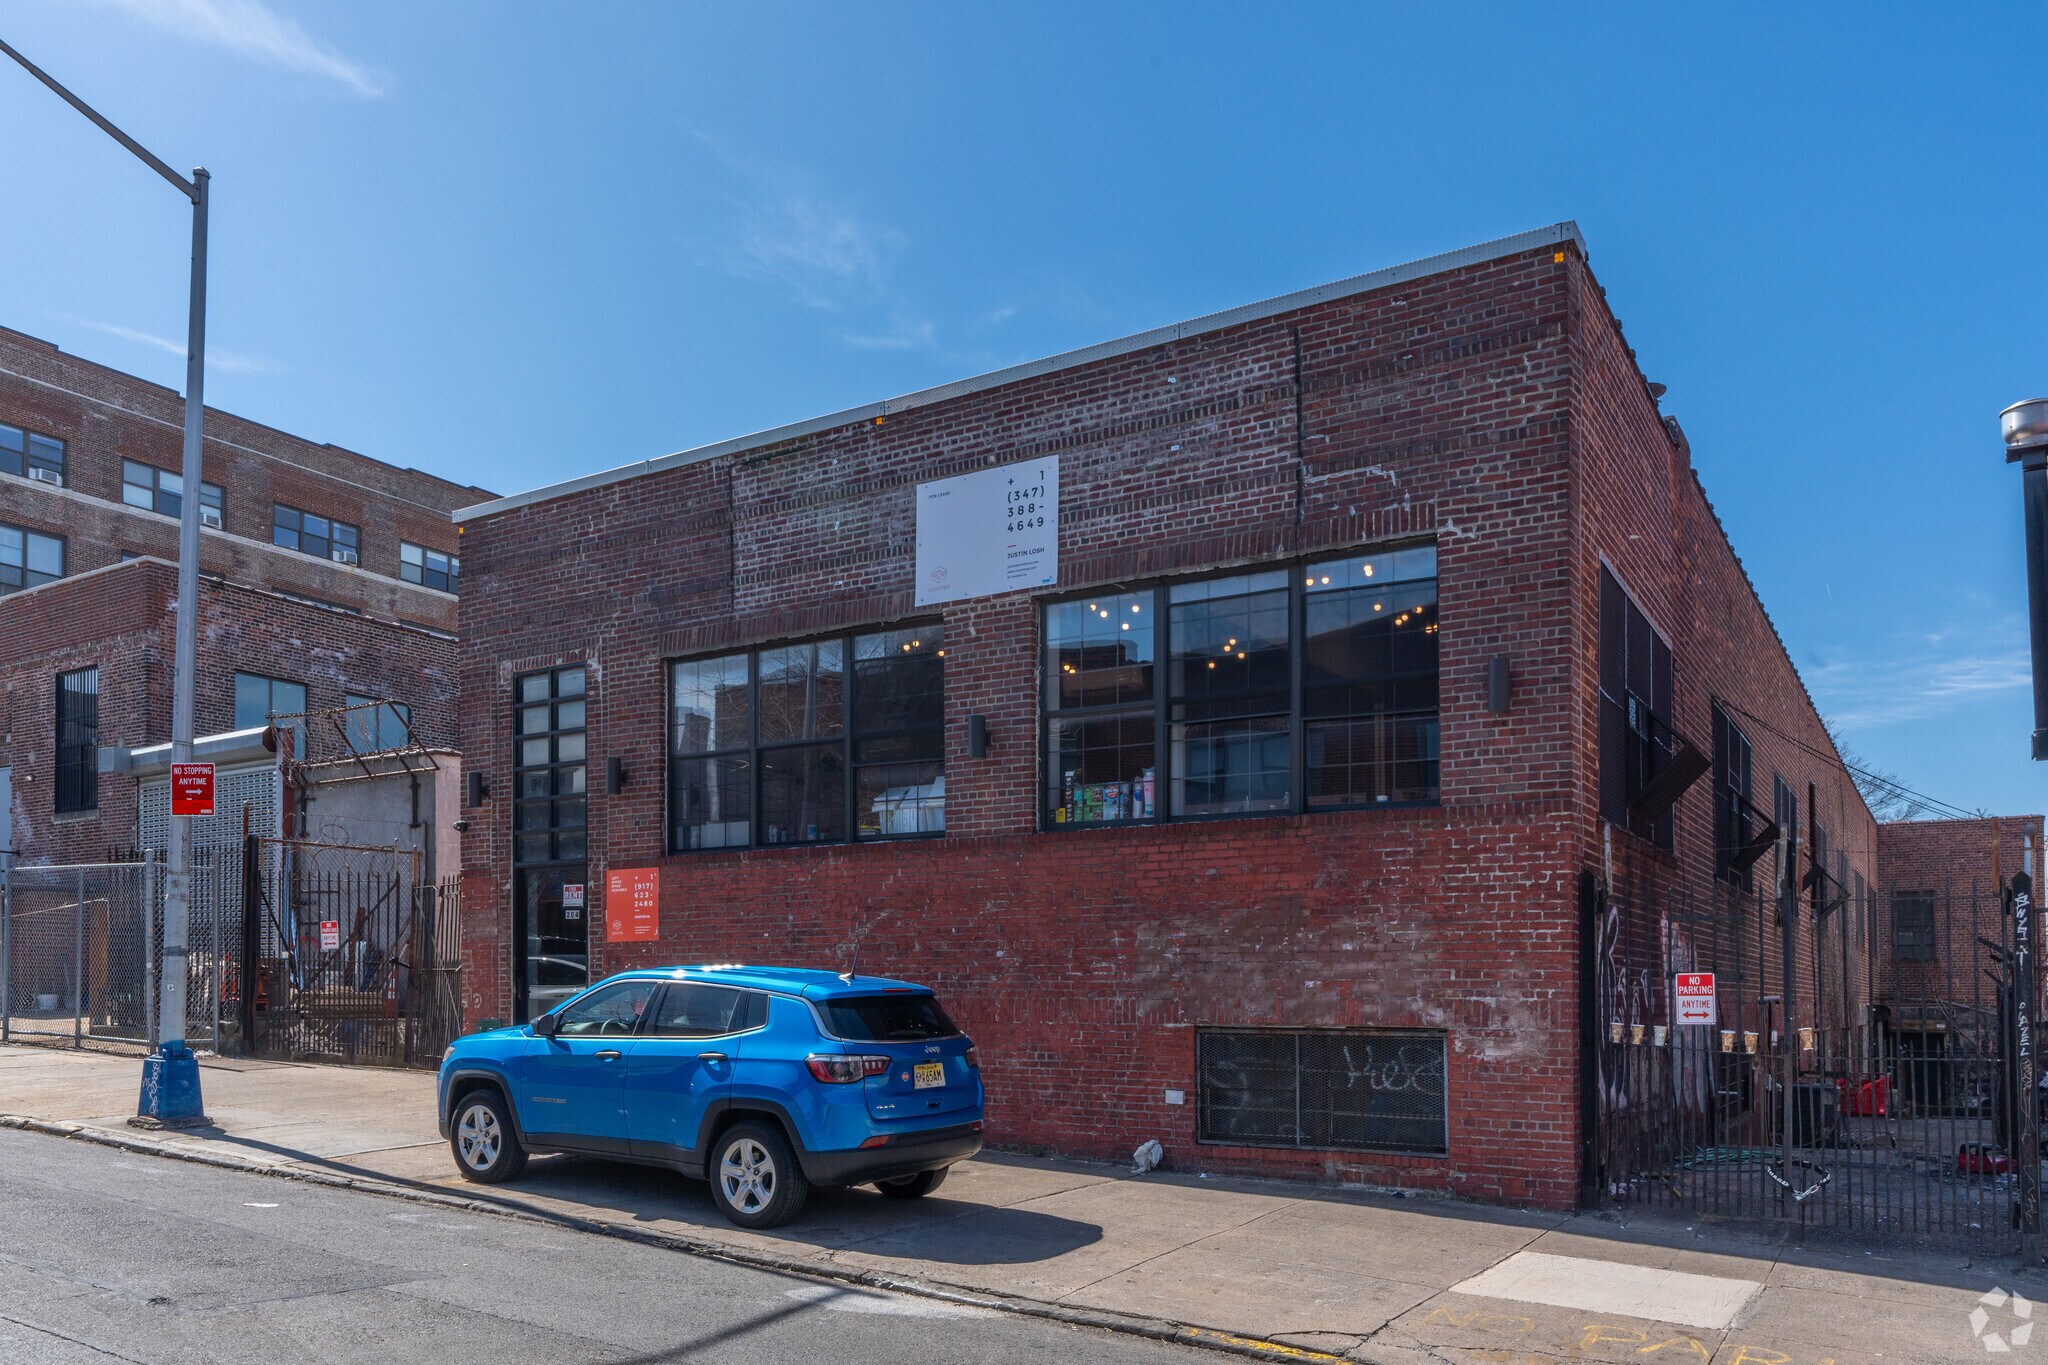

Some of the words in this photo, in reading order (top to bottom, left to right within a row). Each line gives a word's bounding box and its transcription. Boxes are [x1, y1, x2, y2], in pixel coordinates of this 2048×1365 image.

[1007, 485, 1045, 504] (347)
[1008, 503, 1044, 518] 388-
[1007, 516, 1044, 533] 4649
[1007, 550, 1028, 559] JUSTIN
[1029, 547, 1045, 555] LOSH
[927, 585, 951, 593] COUNTER
[173, 767, 182, 775] NO
[183, 766, 212, 775] STOPPING
[178, 777, 207, 785] ANYTIME
[564, 891, 582, 899] RENT
[634, 891, 653, 899] 623-
[634, 900, 653, 908] 2480
[1689, 976, 1701, 985] NO
[1678, 985, 1713, 995] PARKING
[1681, 1000, 1711, 1009] ANYTIME
[925, 1045, 941, 1054] Jeep
